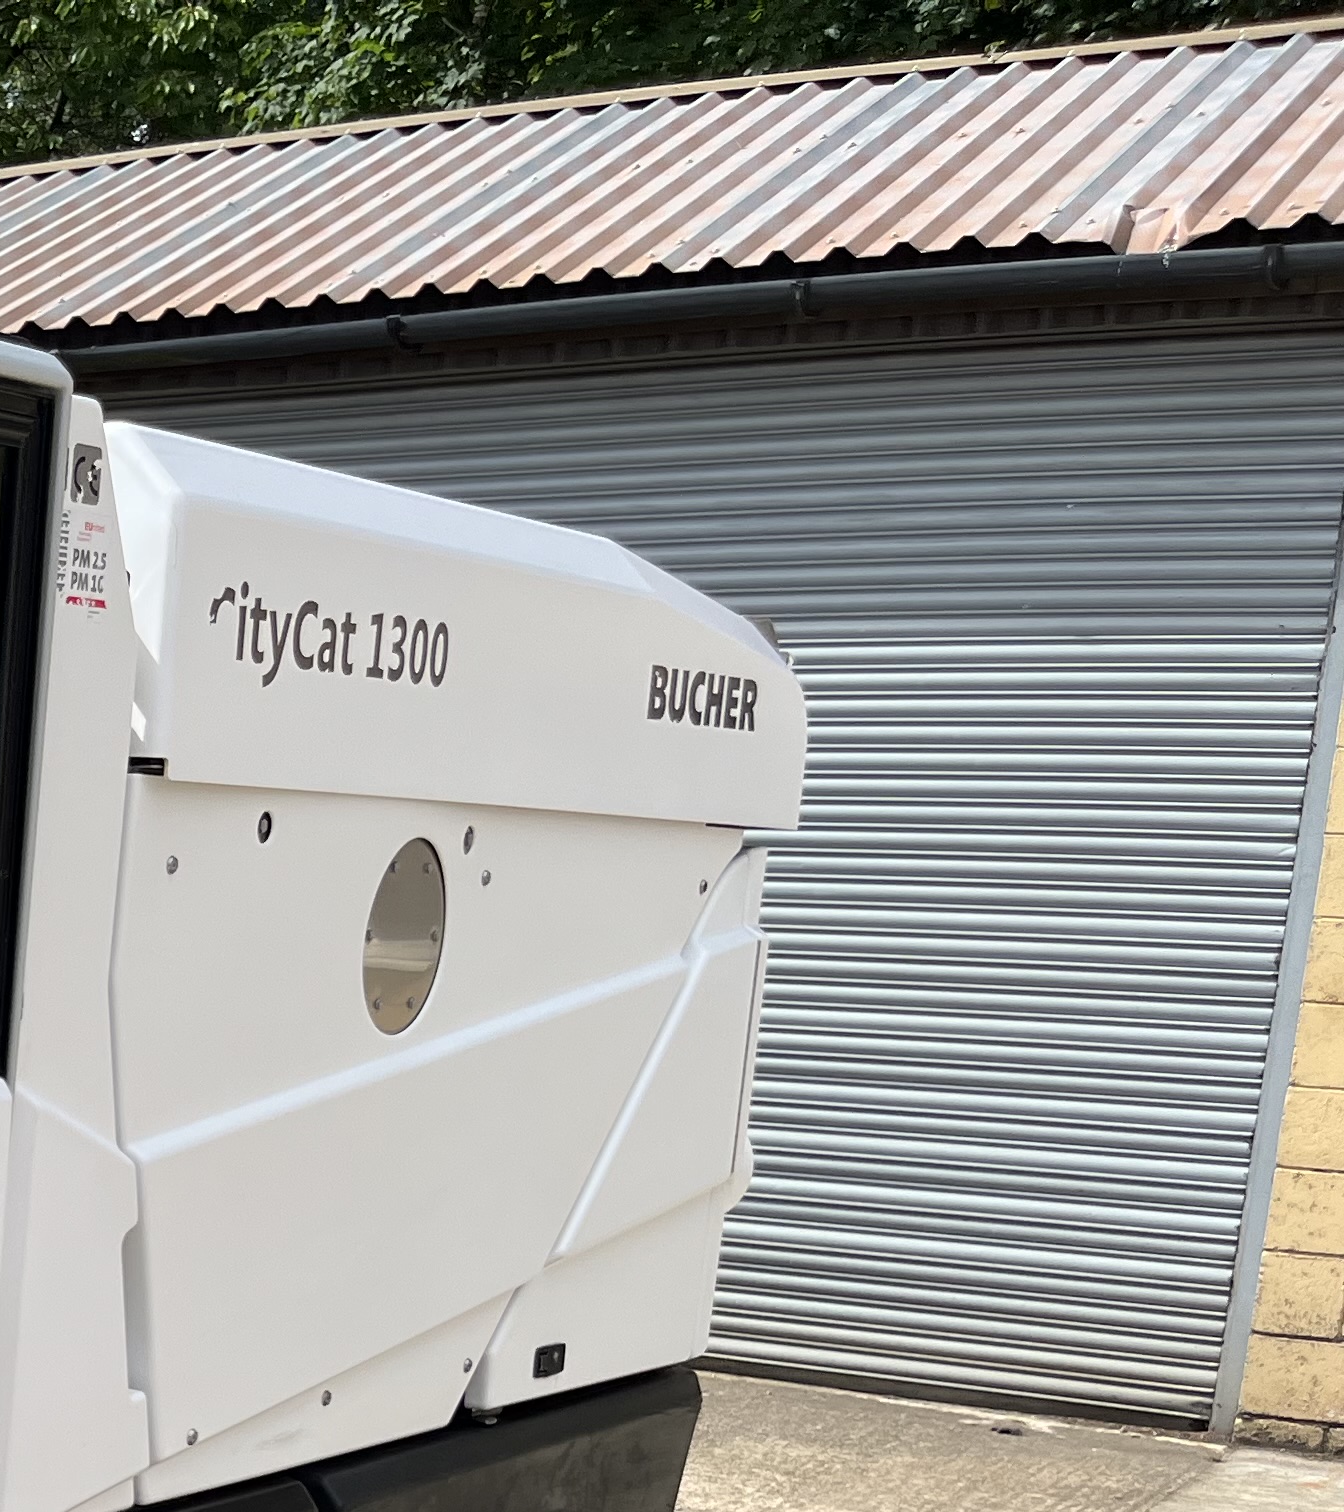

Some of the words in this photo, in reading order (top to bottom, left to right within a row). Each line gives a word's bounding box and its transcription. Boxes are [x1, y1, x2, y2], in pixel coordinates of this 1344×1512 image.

[72, 548, 91, 568] PM
[70, 571, 89, 592] PM
[365, 612, 450, 688] 1300
[646, 664, 759, 732] BUCHER
